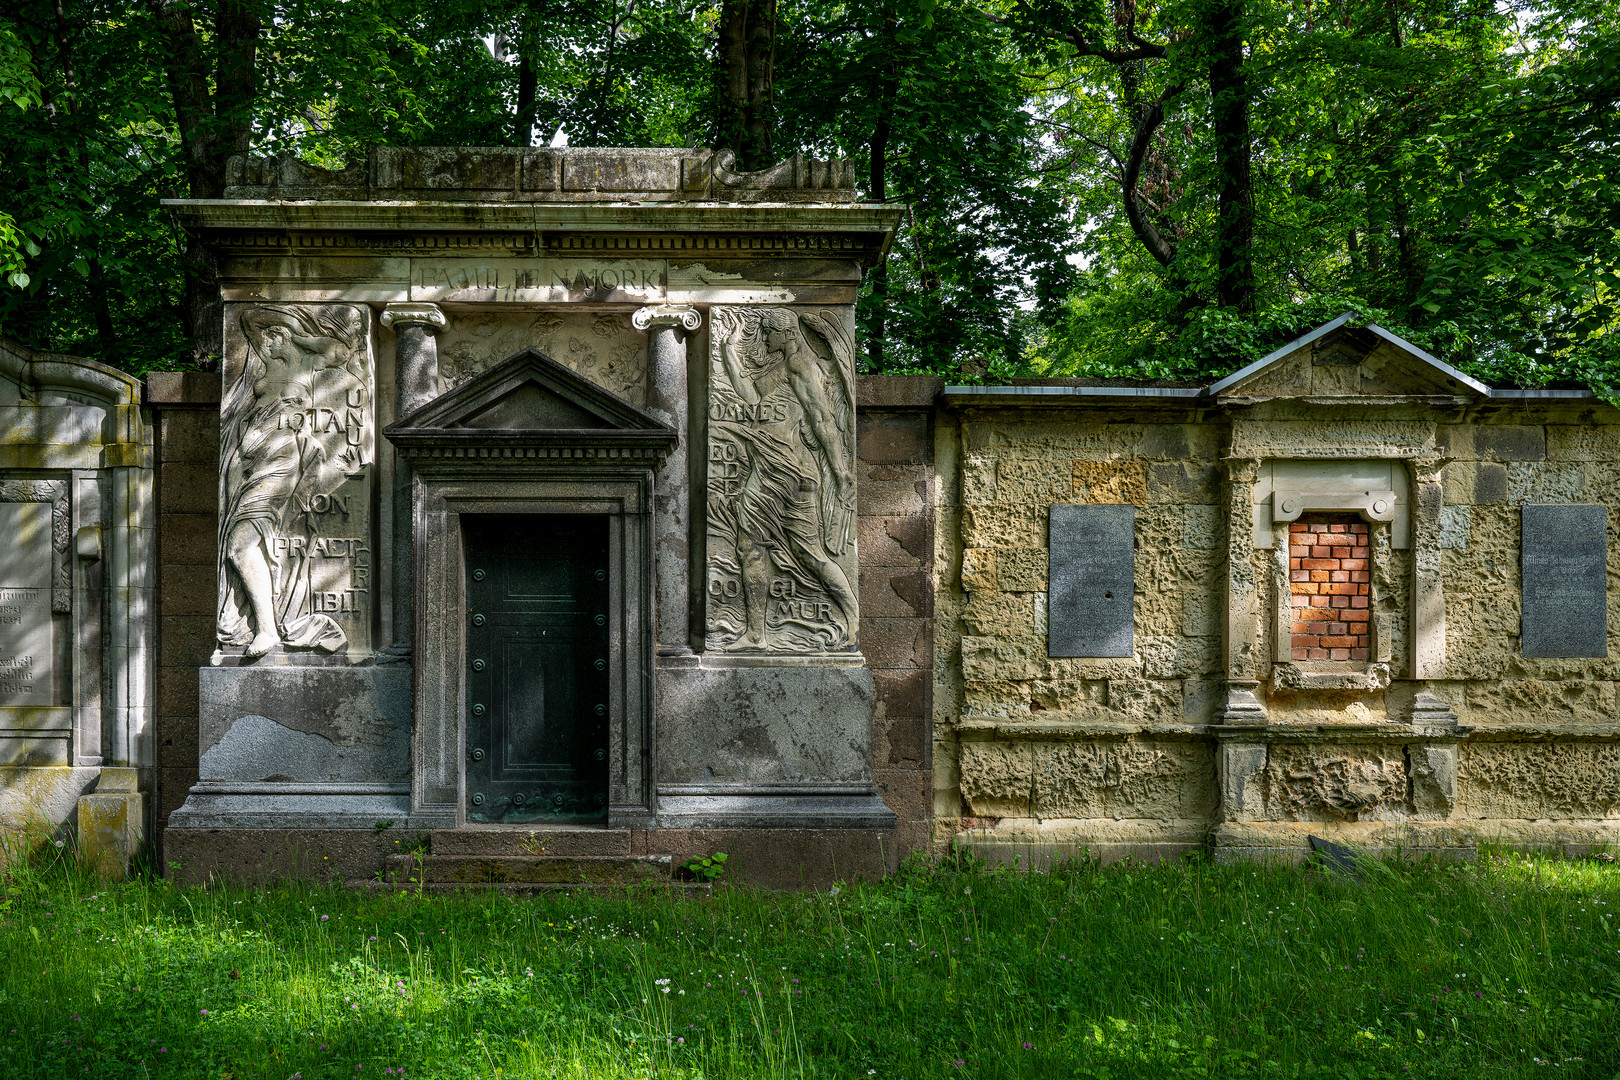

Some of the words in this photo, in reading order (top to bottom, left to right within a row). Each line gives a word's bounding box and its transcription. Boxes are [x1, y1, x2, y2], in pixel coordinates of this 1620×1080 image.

[420, 267, 540, 290] FAMILIE
[708, 402, 788, 421] OMNES
[292, 494, 350, 515] NON
[774, 602, 834, 622] MUR
